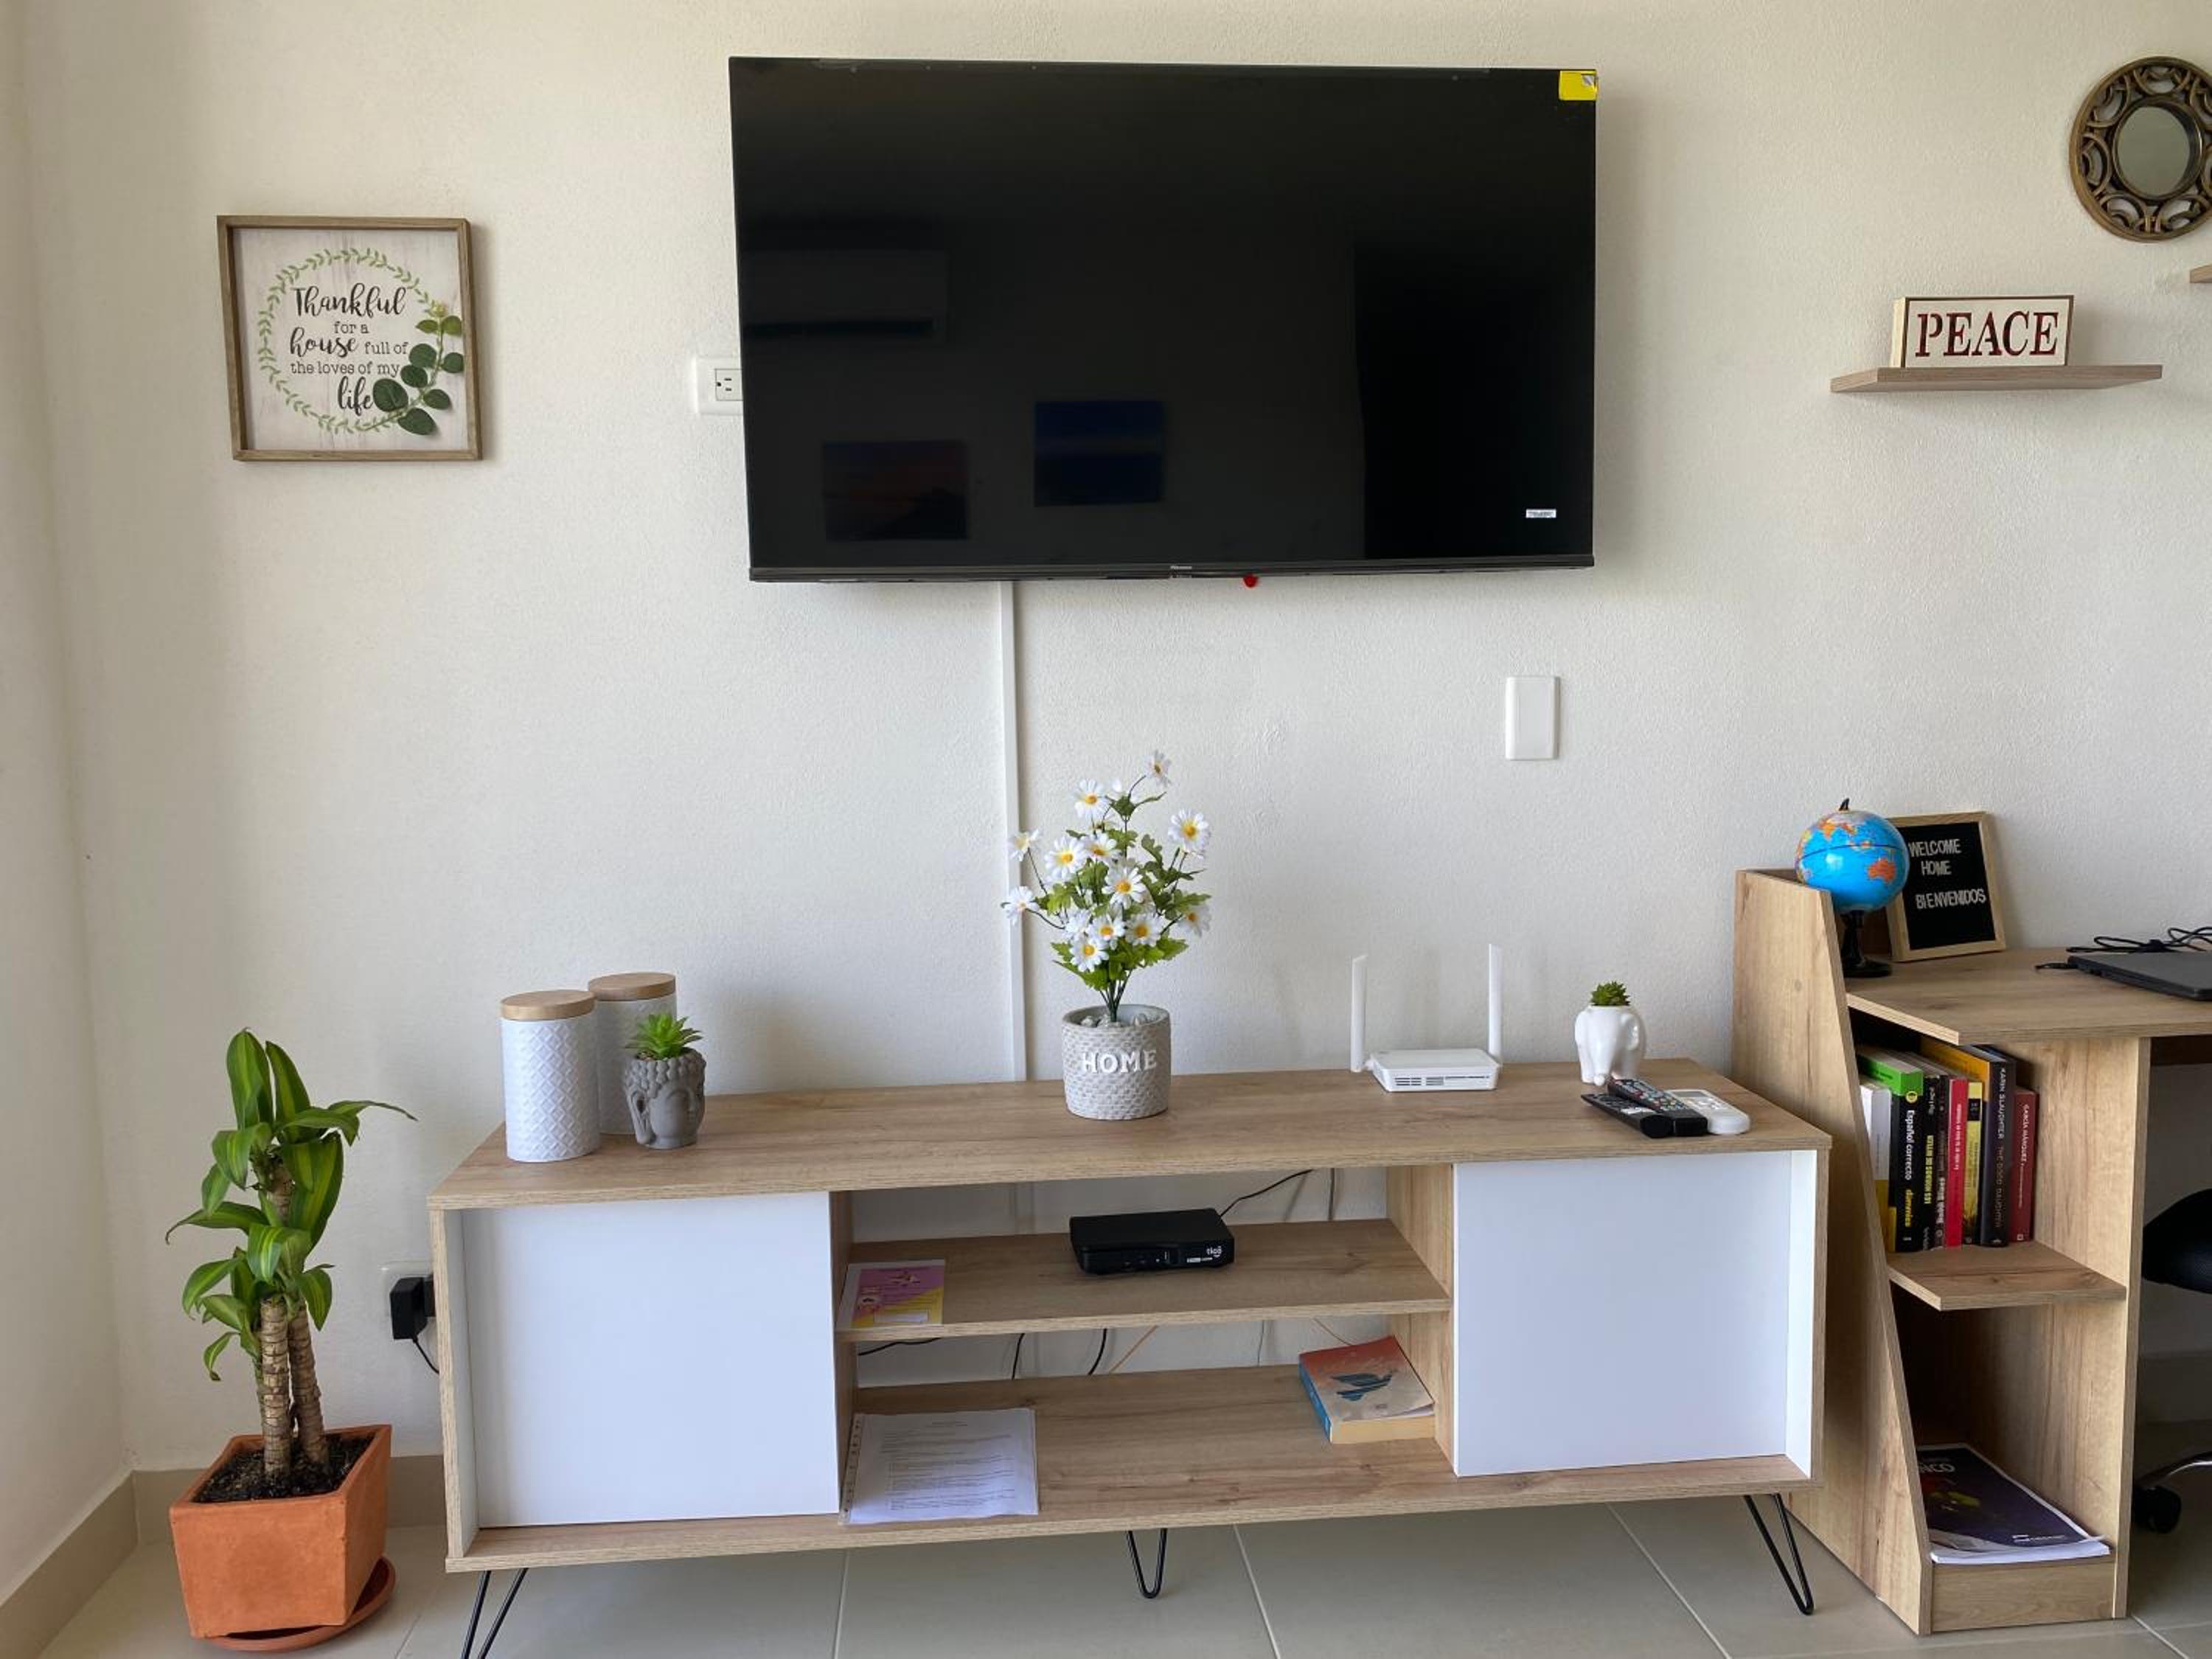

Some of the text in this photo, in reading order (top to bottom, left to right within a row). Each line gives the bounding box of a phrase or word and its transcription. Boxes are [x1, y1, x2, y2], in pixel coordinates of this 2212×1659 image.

[291, 282, 406, 319] Thankful
[334, 321, 370, 334] for a
[1915, 310, 2059, 357] PEACE
[290, 327, 408, 358] house full of
[291, 361, 400, 378] the loves of my
[337, 375, 374, 417] life
[1908, 838, 1962, 858] WELCOME
[1921, 860, 1952, 877] HOME
[1916, 888, 1987, 910] BIENVENIDOS
[1081, 1048, 1158, 1074] HOME
